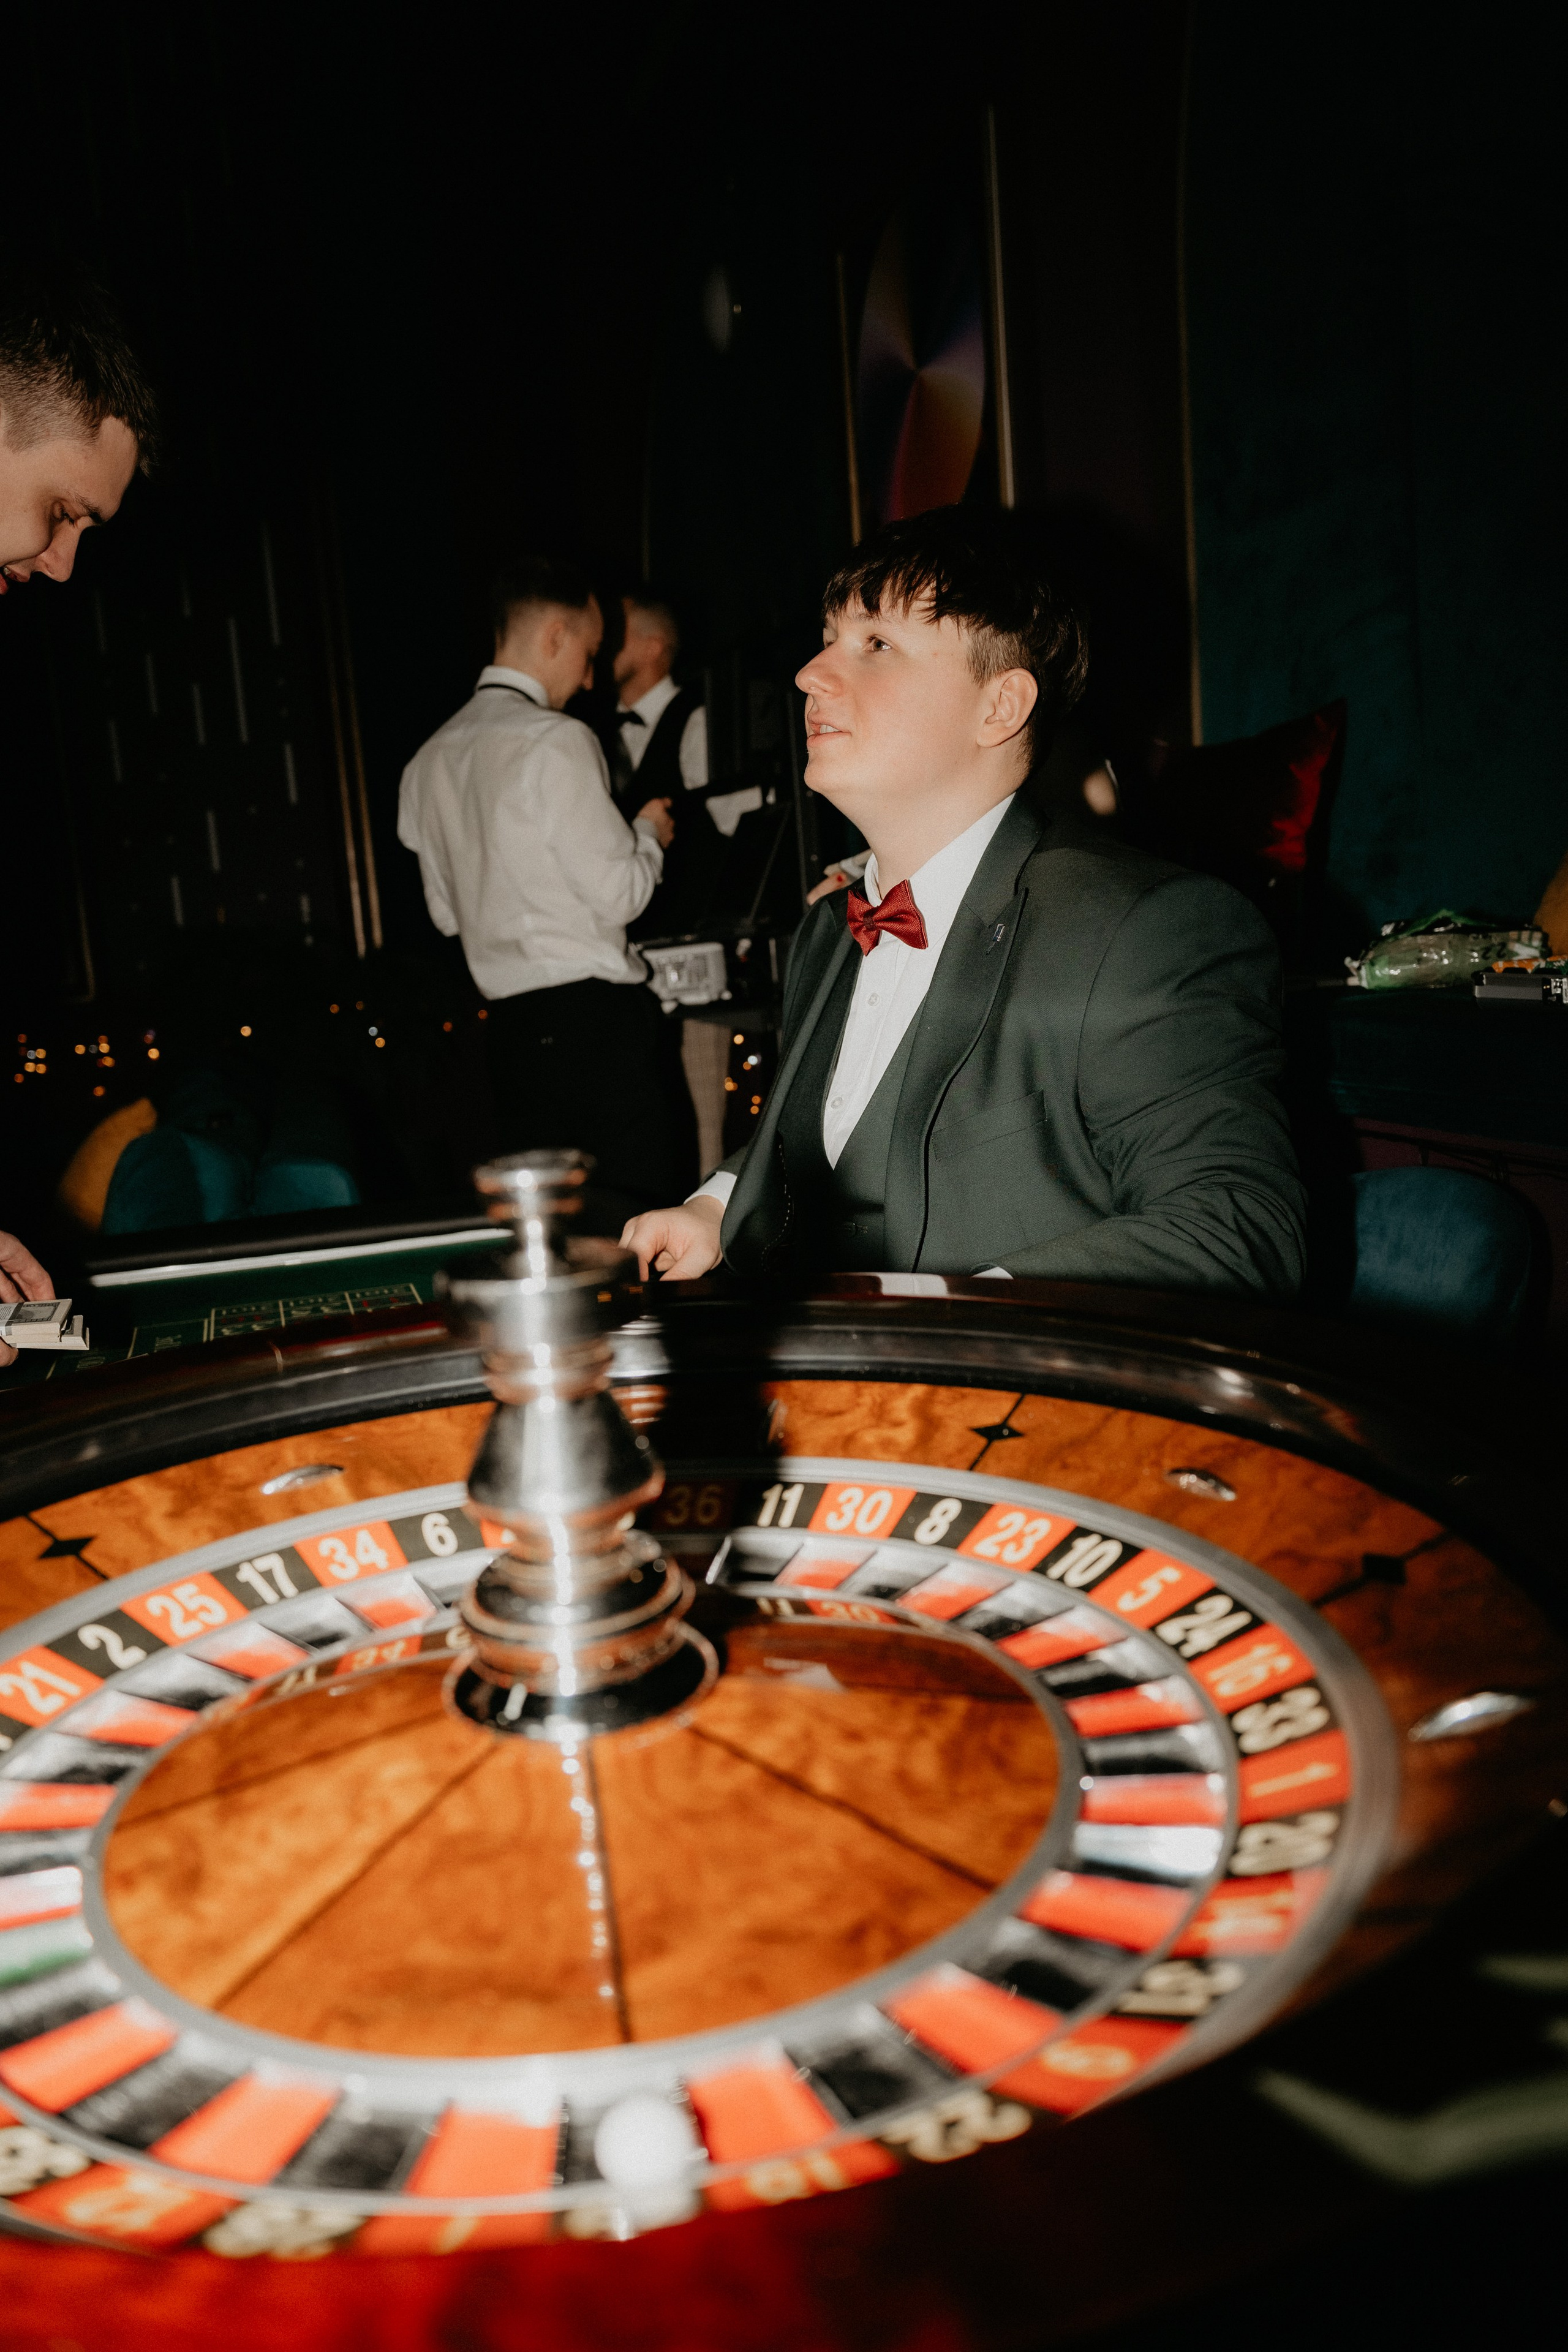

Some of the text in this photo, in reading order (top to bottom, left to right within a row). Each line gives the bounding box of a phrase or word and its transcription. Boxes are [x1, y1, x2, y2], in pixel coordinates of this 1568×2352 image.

[662, 1484, 723, 1525] 36
[757, 1483, 805, 1528] 11
[825, 1487, 894, 1535] 30
[914, 1498, 962, 1545] 8
[317, 1529, 388, 1580] 34
[420, 1512, 458, 1557] 6
[973, 1512, 1051, 1564] 23
[236, 1553, 298, 1604] 17
[1046, 1533, 1123, 1588] 10
[146, 1583, 227, 1638] 25
[1118, 1566, 1182, 1613] 5
[77, 1623, 147, 1669] 2
[1155, 1594, 1253, 1659] 24
[0, 1661, 81, 1714] 21
[1231, 1686, 1330, 1755] 33
